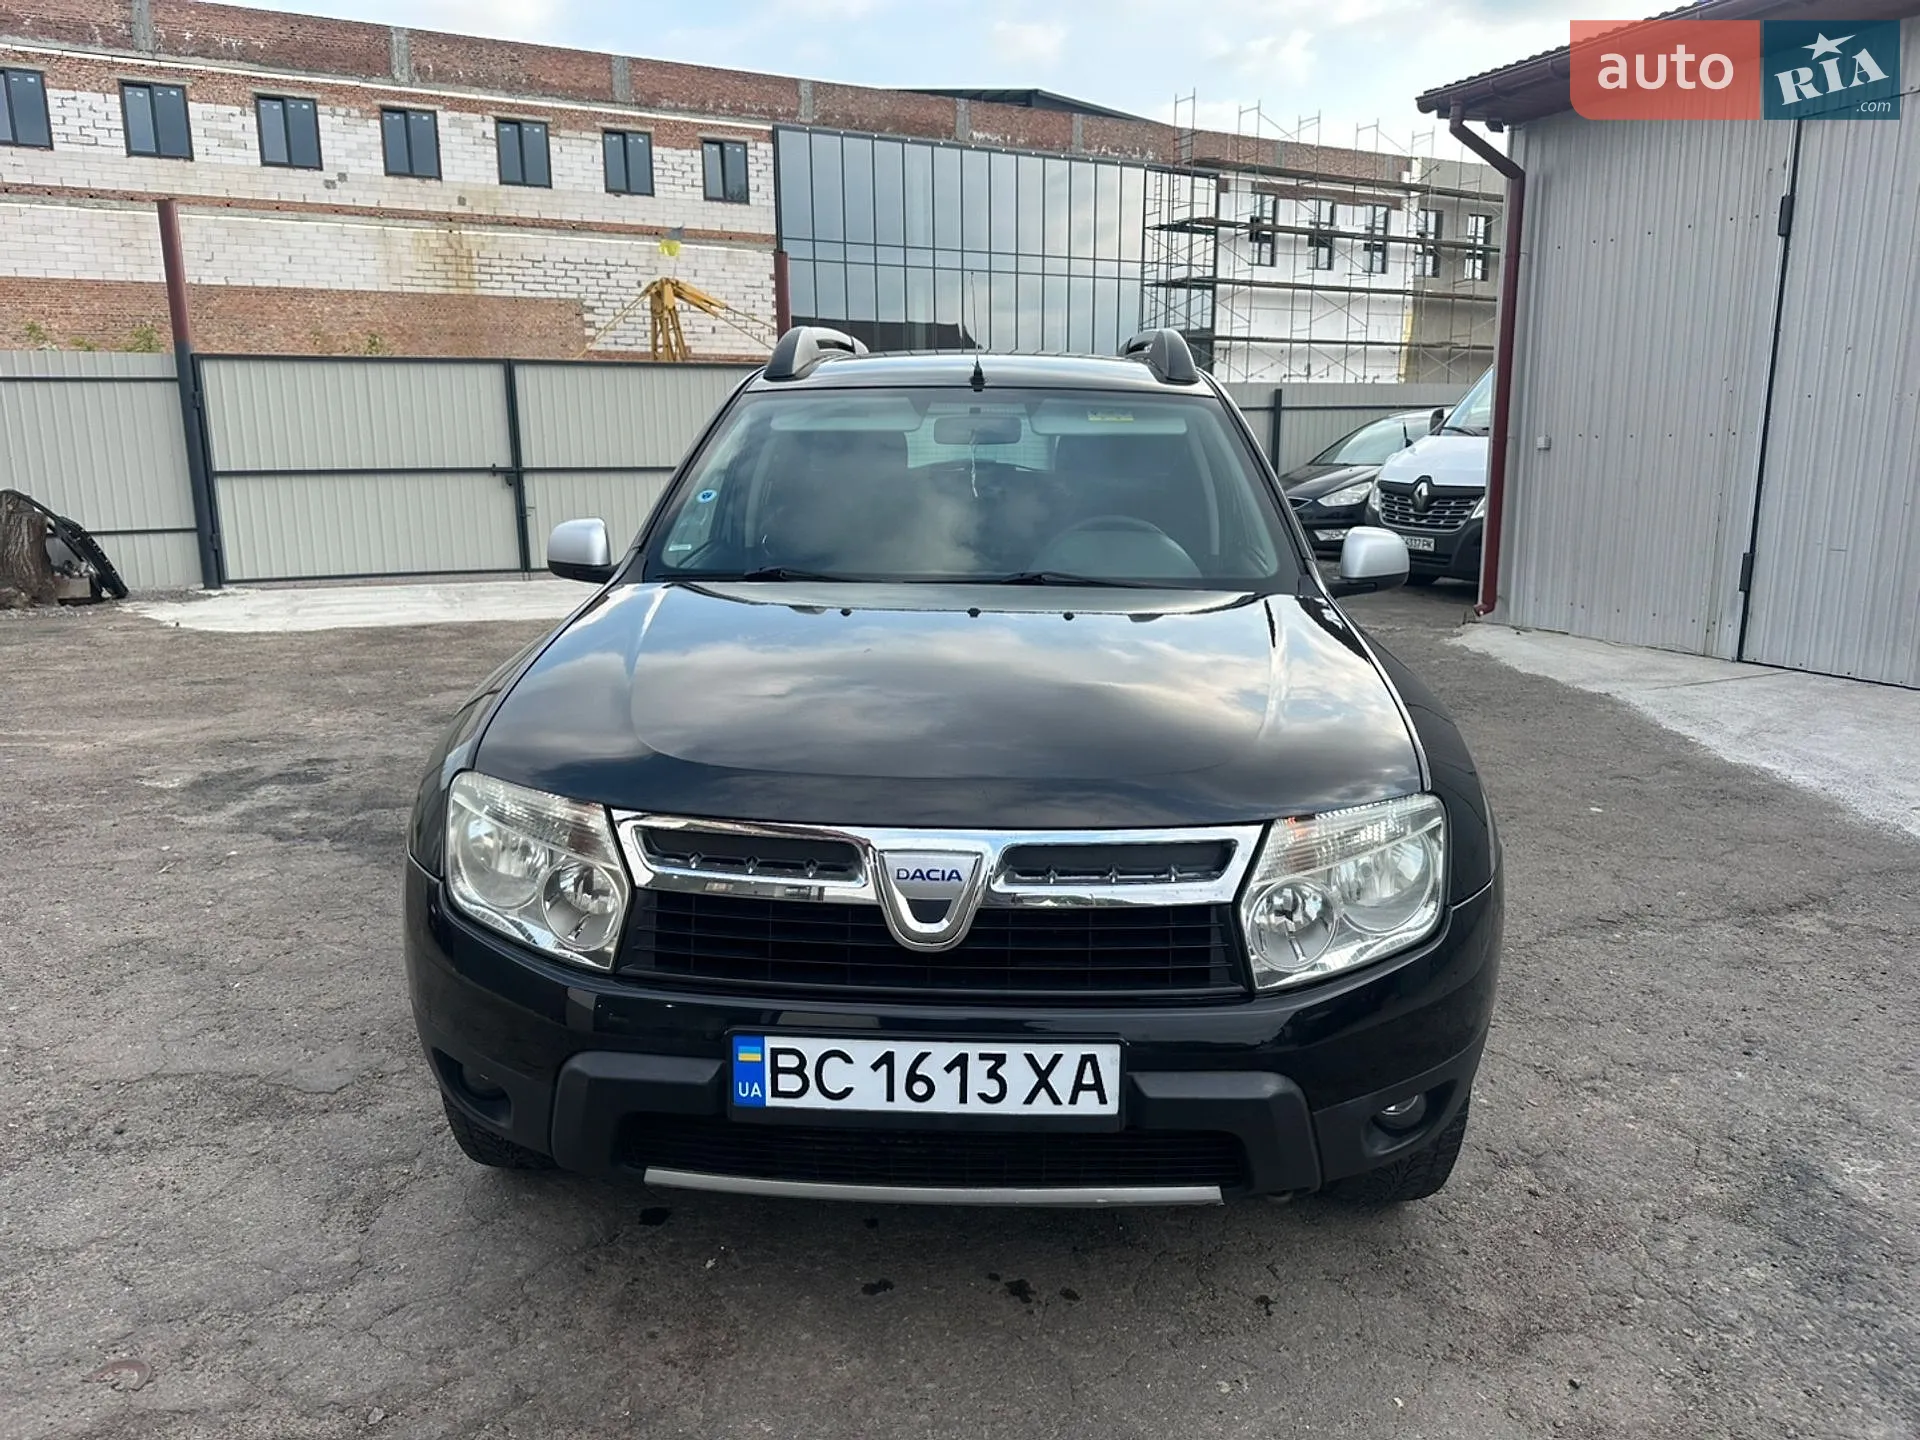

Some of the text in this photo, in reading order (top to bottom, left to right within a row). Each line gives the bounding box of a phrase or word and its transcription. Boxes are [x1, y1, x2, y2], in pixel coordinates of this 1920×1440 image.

[896, 868, 962, 882] DACIA
[769, 1047, 1108, 1106] BC 1613 XA
[738, 1081, 762, 1098] UA
